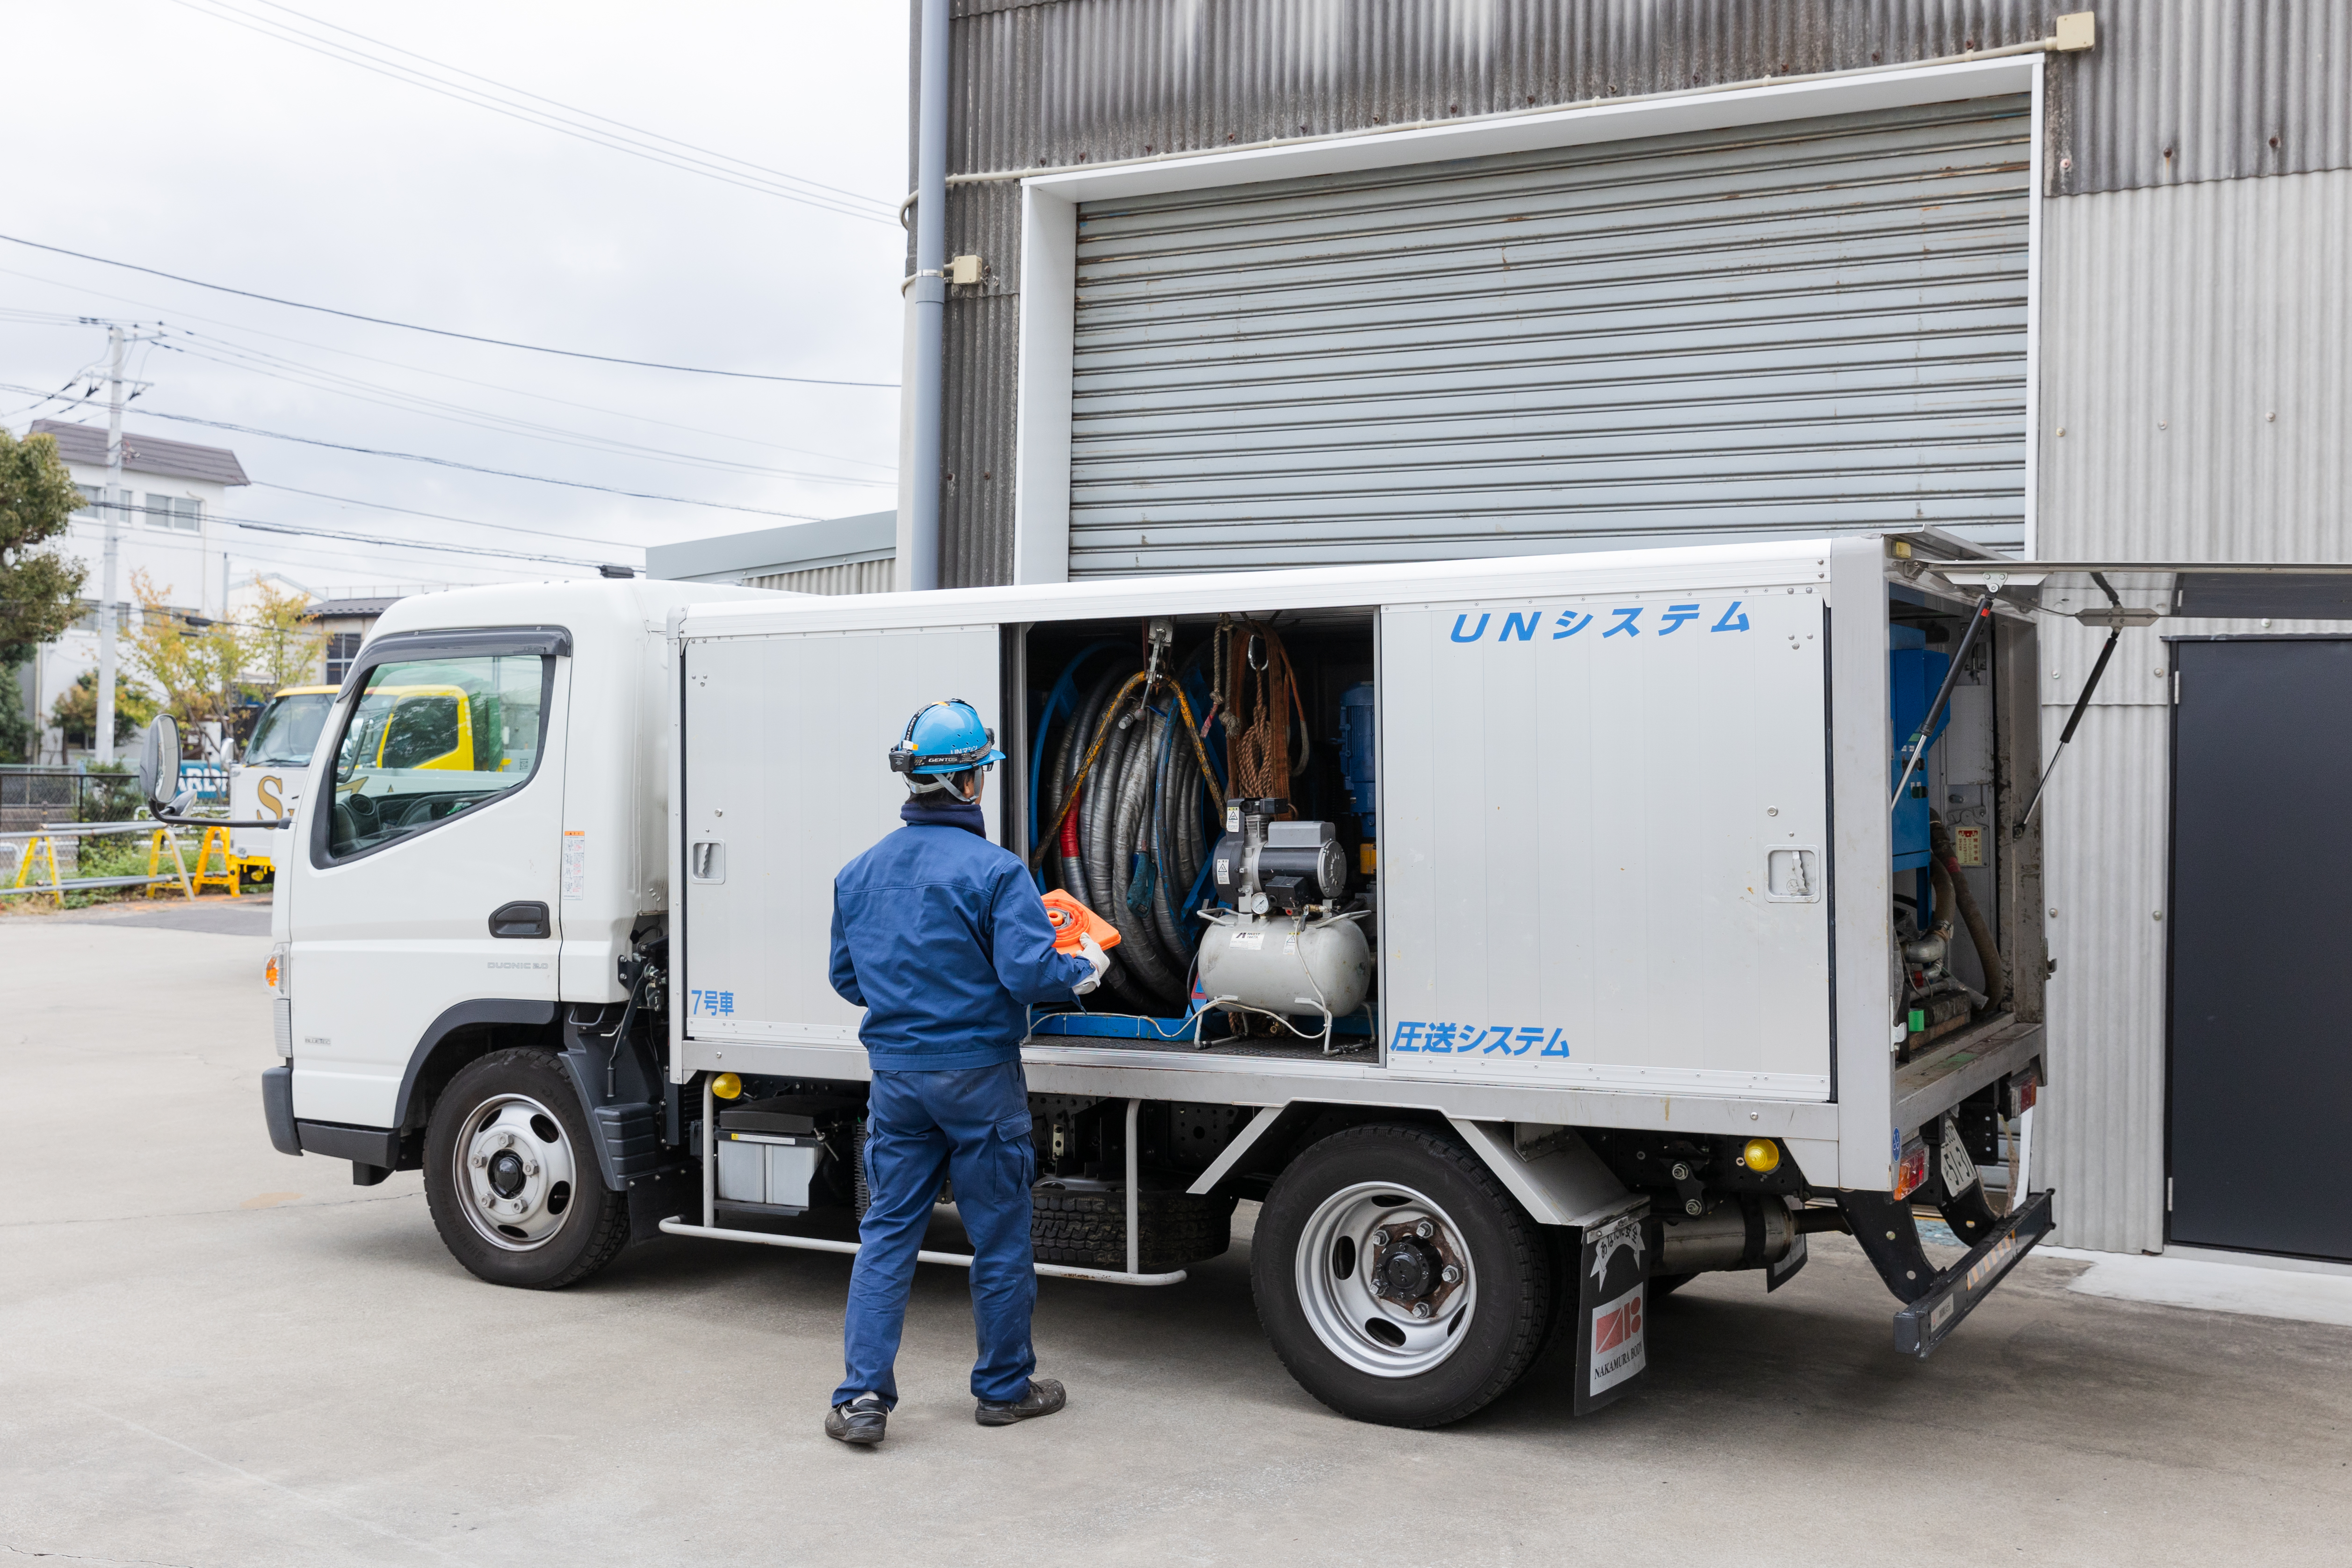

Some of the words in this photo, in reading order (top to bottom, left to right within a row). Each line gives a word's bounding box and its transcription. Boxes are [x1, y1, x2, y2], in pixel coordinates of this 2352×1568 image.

[1450, 601, 1750, 643] UNシステム
[691, 990, 734, 1016] 7号車
[1390, 1021, 1570, 1059] 圧送システム
[1594, 1351, 1630, 1380] NAKAMURA
[1631, 1341, 1642, 1360] BODY
